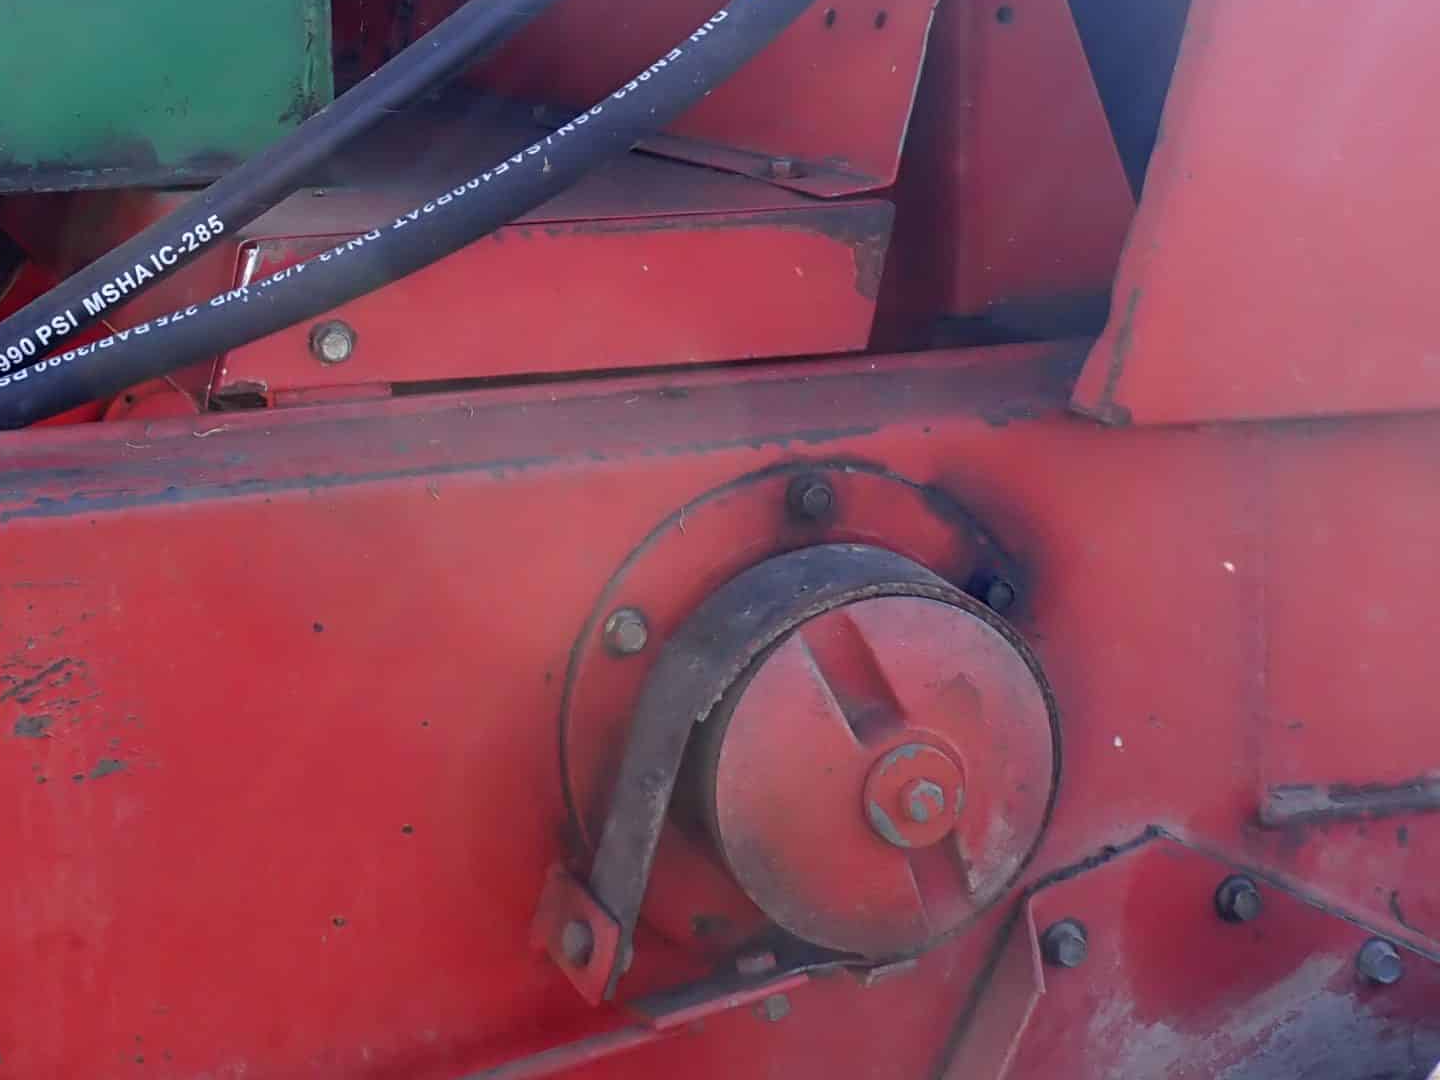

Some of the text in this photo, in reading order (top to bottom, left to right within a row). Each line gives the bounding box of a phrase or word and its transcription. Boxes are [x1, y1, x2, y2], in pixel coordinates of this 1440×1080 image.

[35, 309, 79, 346] PSI
[82, 264, 154, 316] MSHA
[150, 214, 225, 272] IC-285
